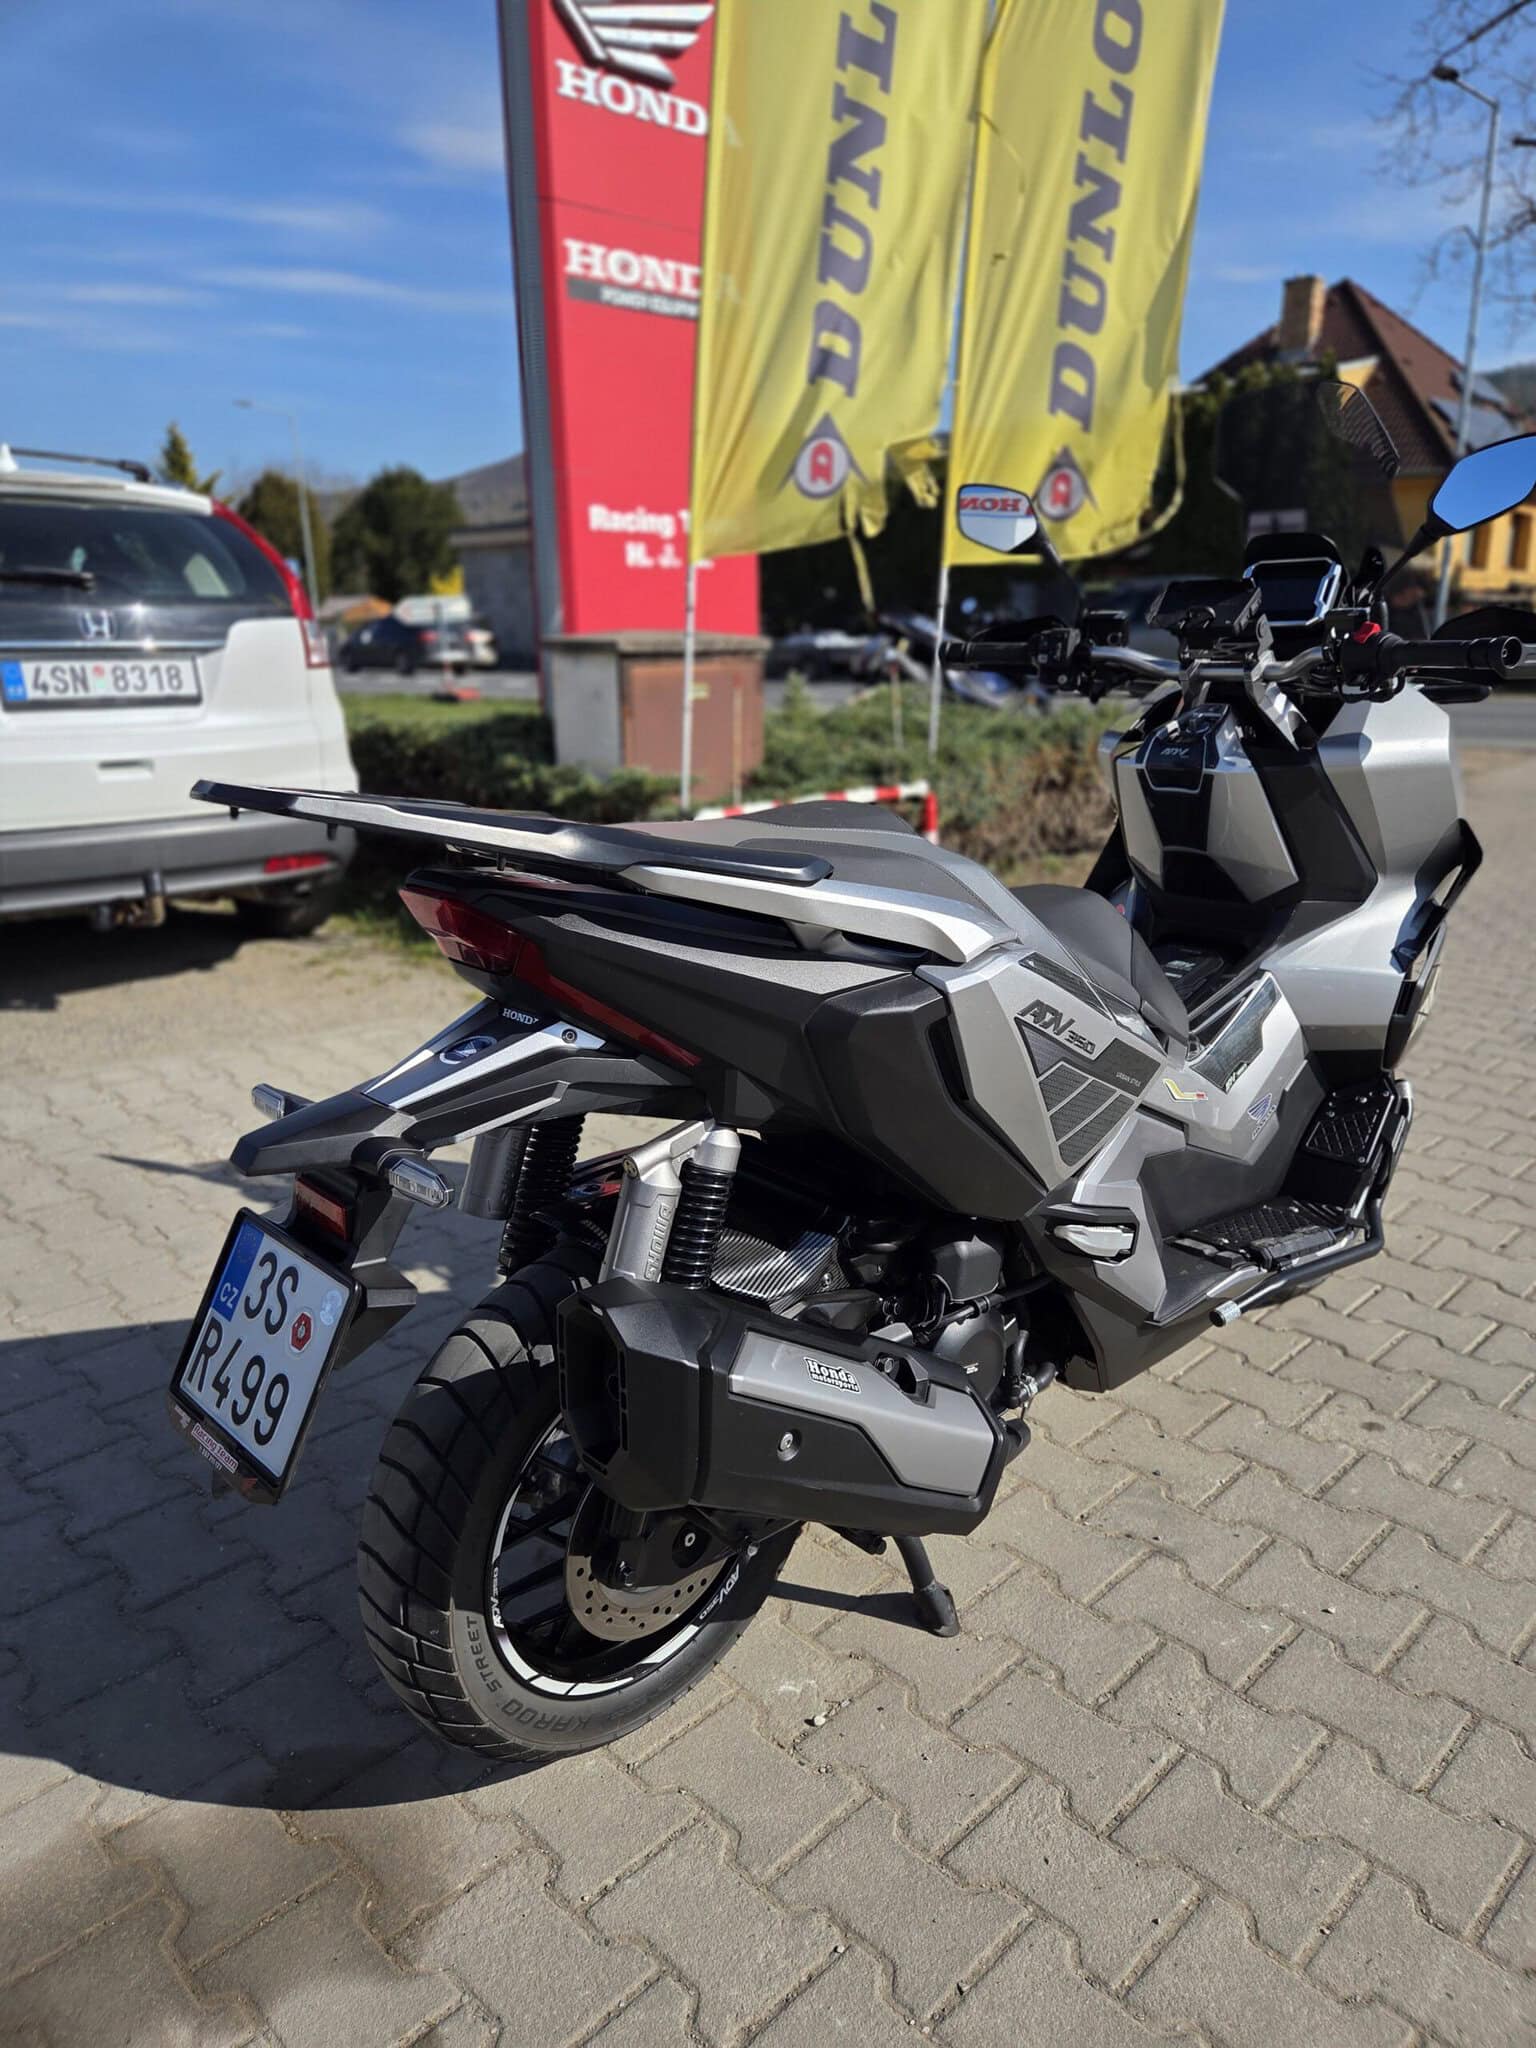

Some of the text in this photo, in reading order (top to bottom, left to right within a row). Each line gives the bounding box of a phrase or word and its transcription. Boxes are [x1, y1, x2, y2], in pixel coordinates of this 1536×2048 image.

[555, 58, 708, 137] HOND
[563, 238, 704, 298] HOND
[32, 665, 90, 695] 4SN
[111, 664, 184, 692] 8318
[1016, 998, 1097, 1055] ADV 350
[219, 1282, 238, 1308] CZ
[244, 1250, 299, 1336] 3S
[186, 1315, 290, 1447] R499
[807, 1359, 857, 1385] Honda
[216, 1446, 238, 1470] Team
[469, 1617, 502, 1693] STREET
[501, 1700, 591, 1732] KAROO
